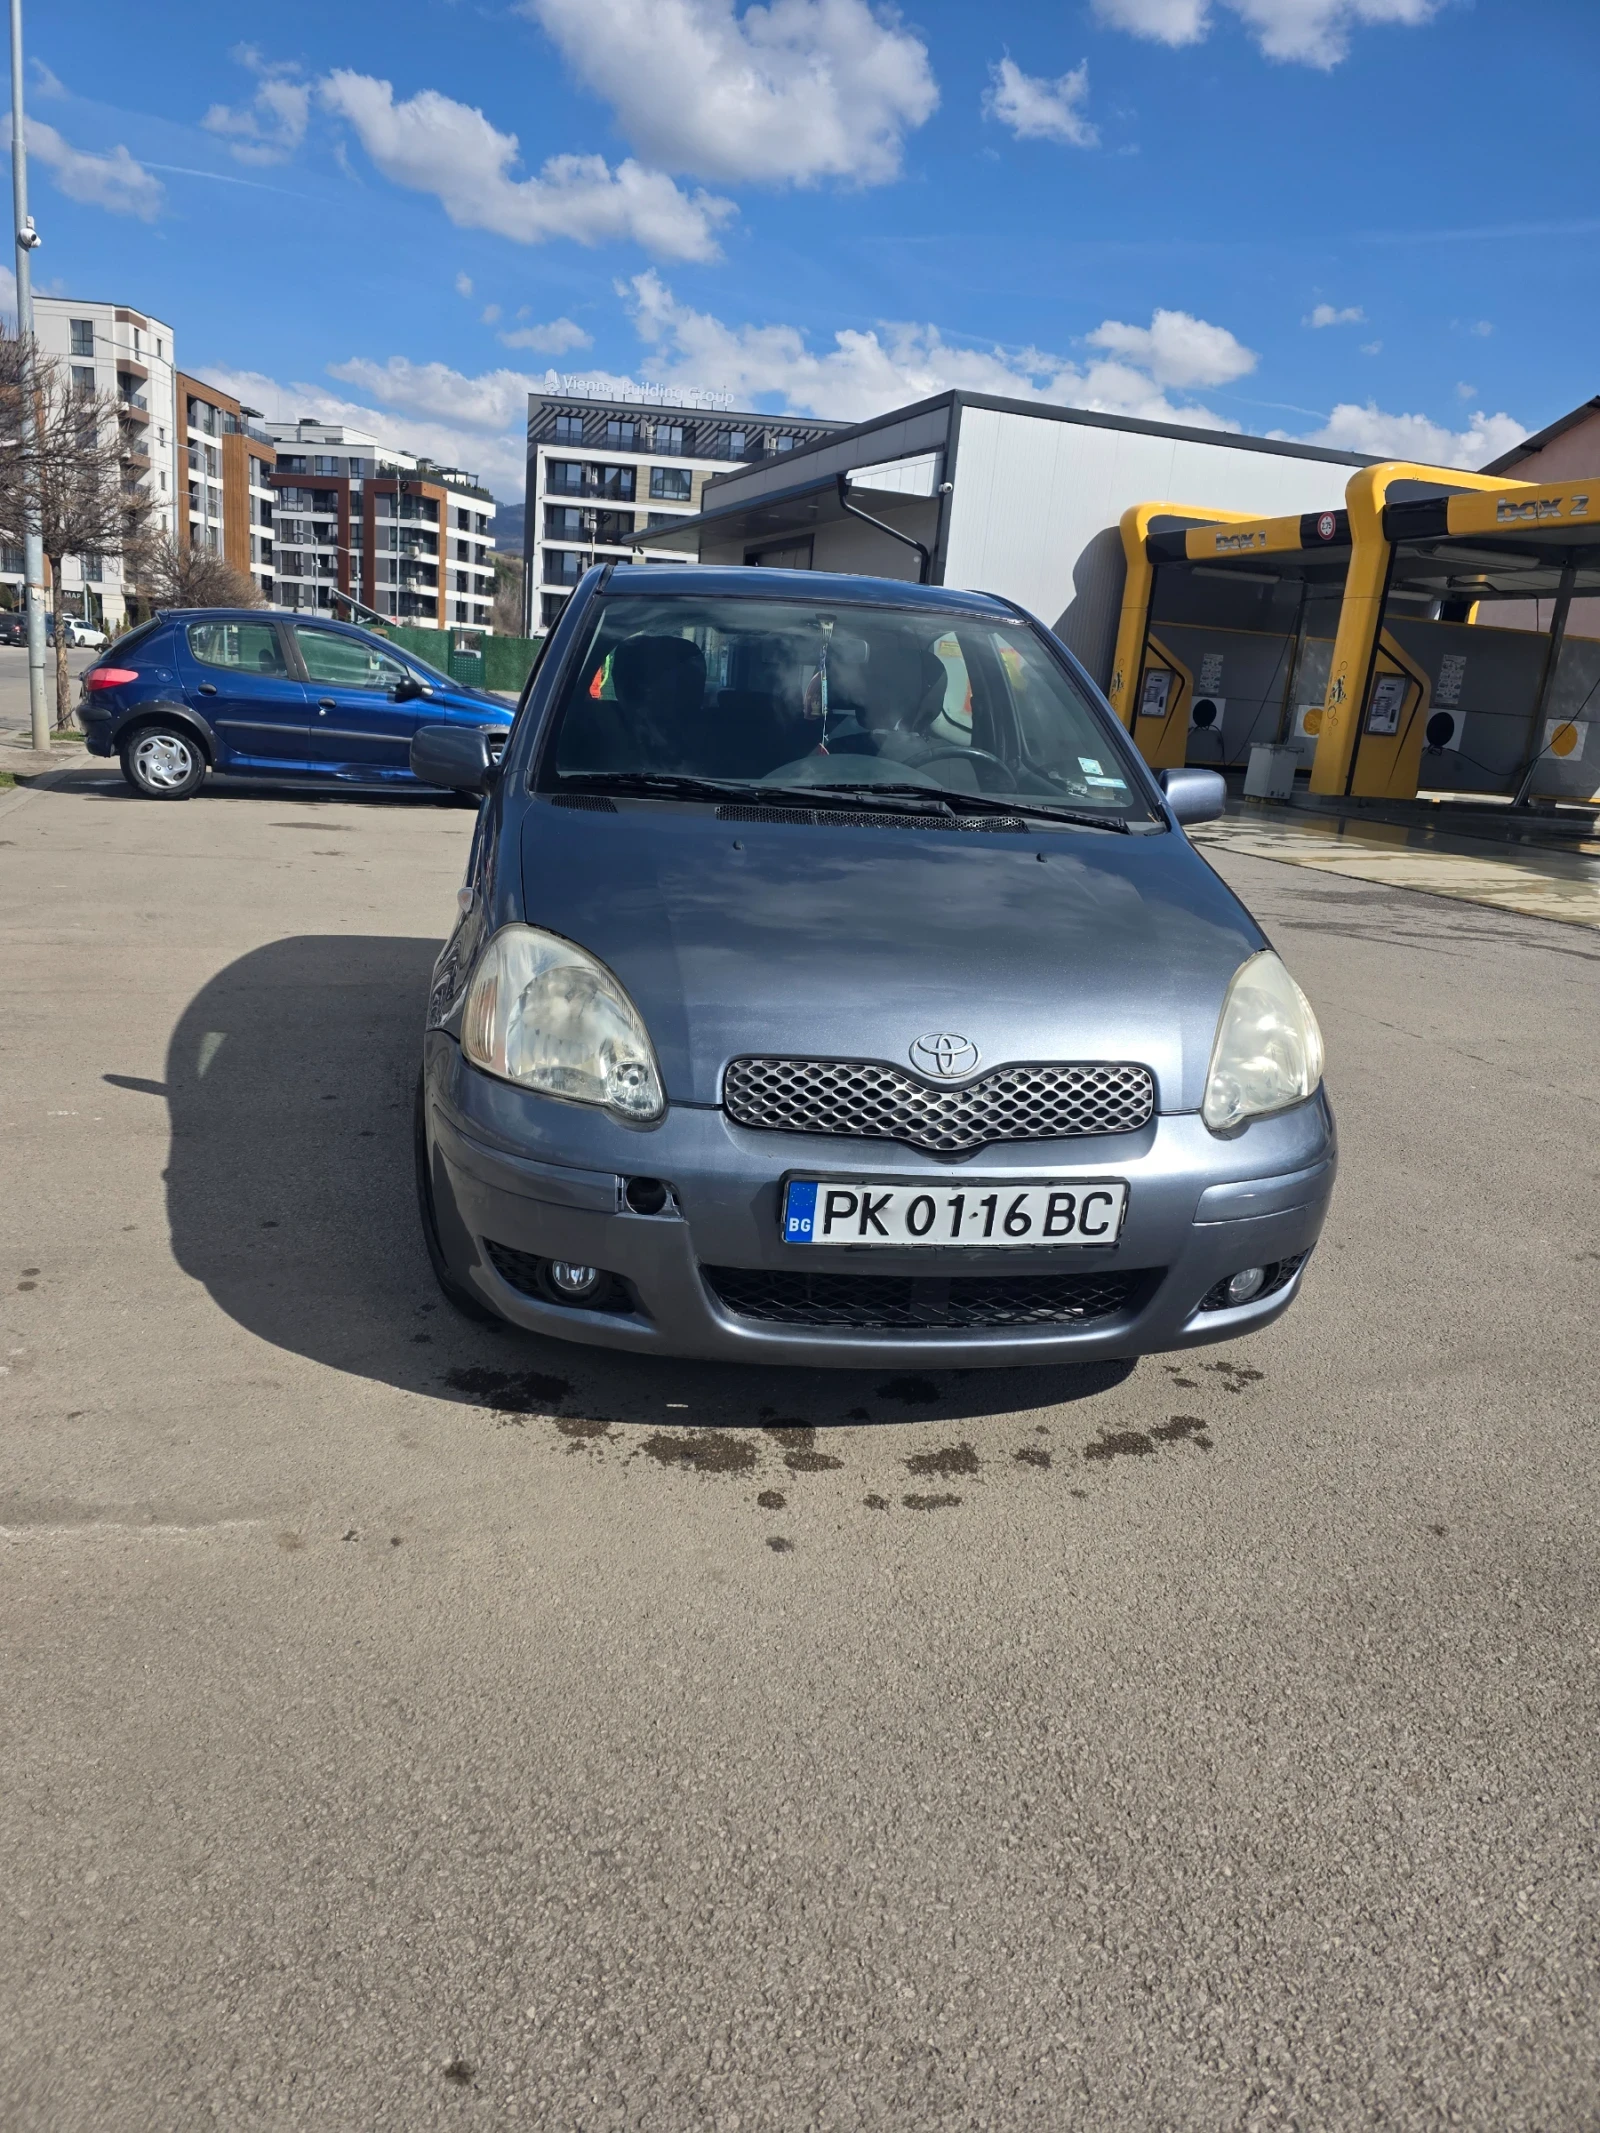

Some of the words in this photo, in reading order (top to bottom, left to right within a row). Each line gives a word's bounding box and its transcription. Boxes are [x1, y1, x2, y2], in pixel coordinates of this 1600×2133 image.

[563, 375, 613, 393] Vienna
[621, 381, 683, 400] Building
[687, 387, 735, 405] Group
[1497, 497, 1562, 522] box
[1570, 495, 1588, 516] 2
[1215, 532, 1255, 551] box
[1258, 530, 1266, 547] 1
[788, 1217, 811, 1233] BG
[822, 1190, 894, 1236] PK
[905, 1193, 1032, 1238] 0116
[1042, 1191, 1113, 1237] BC
